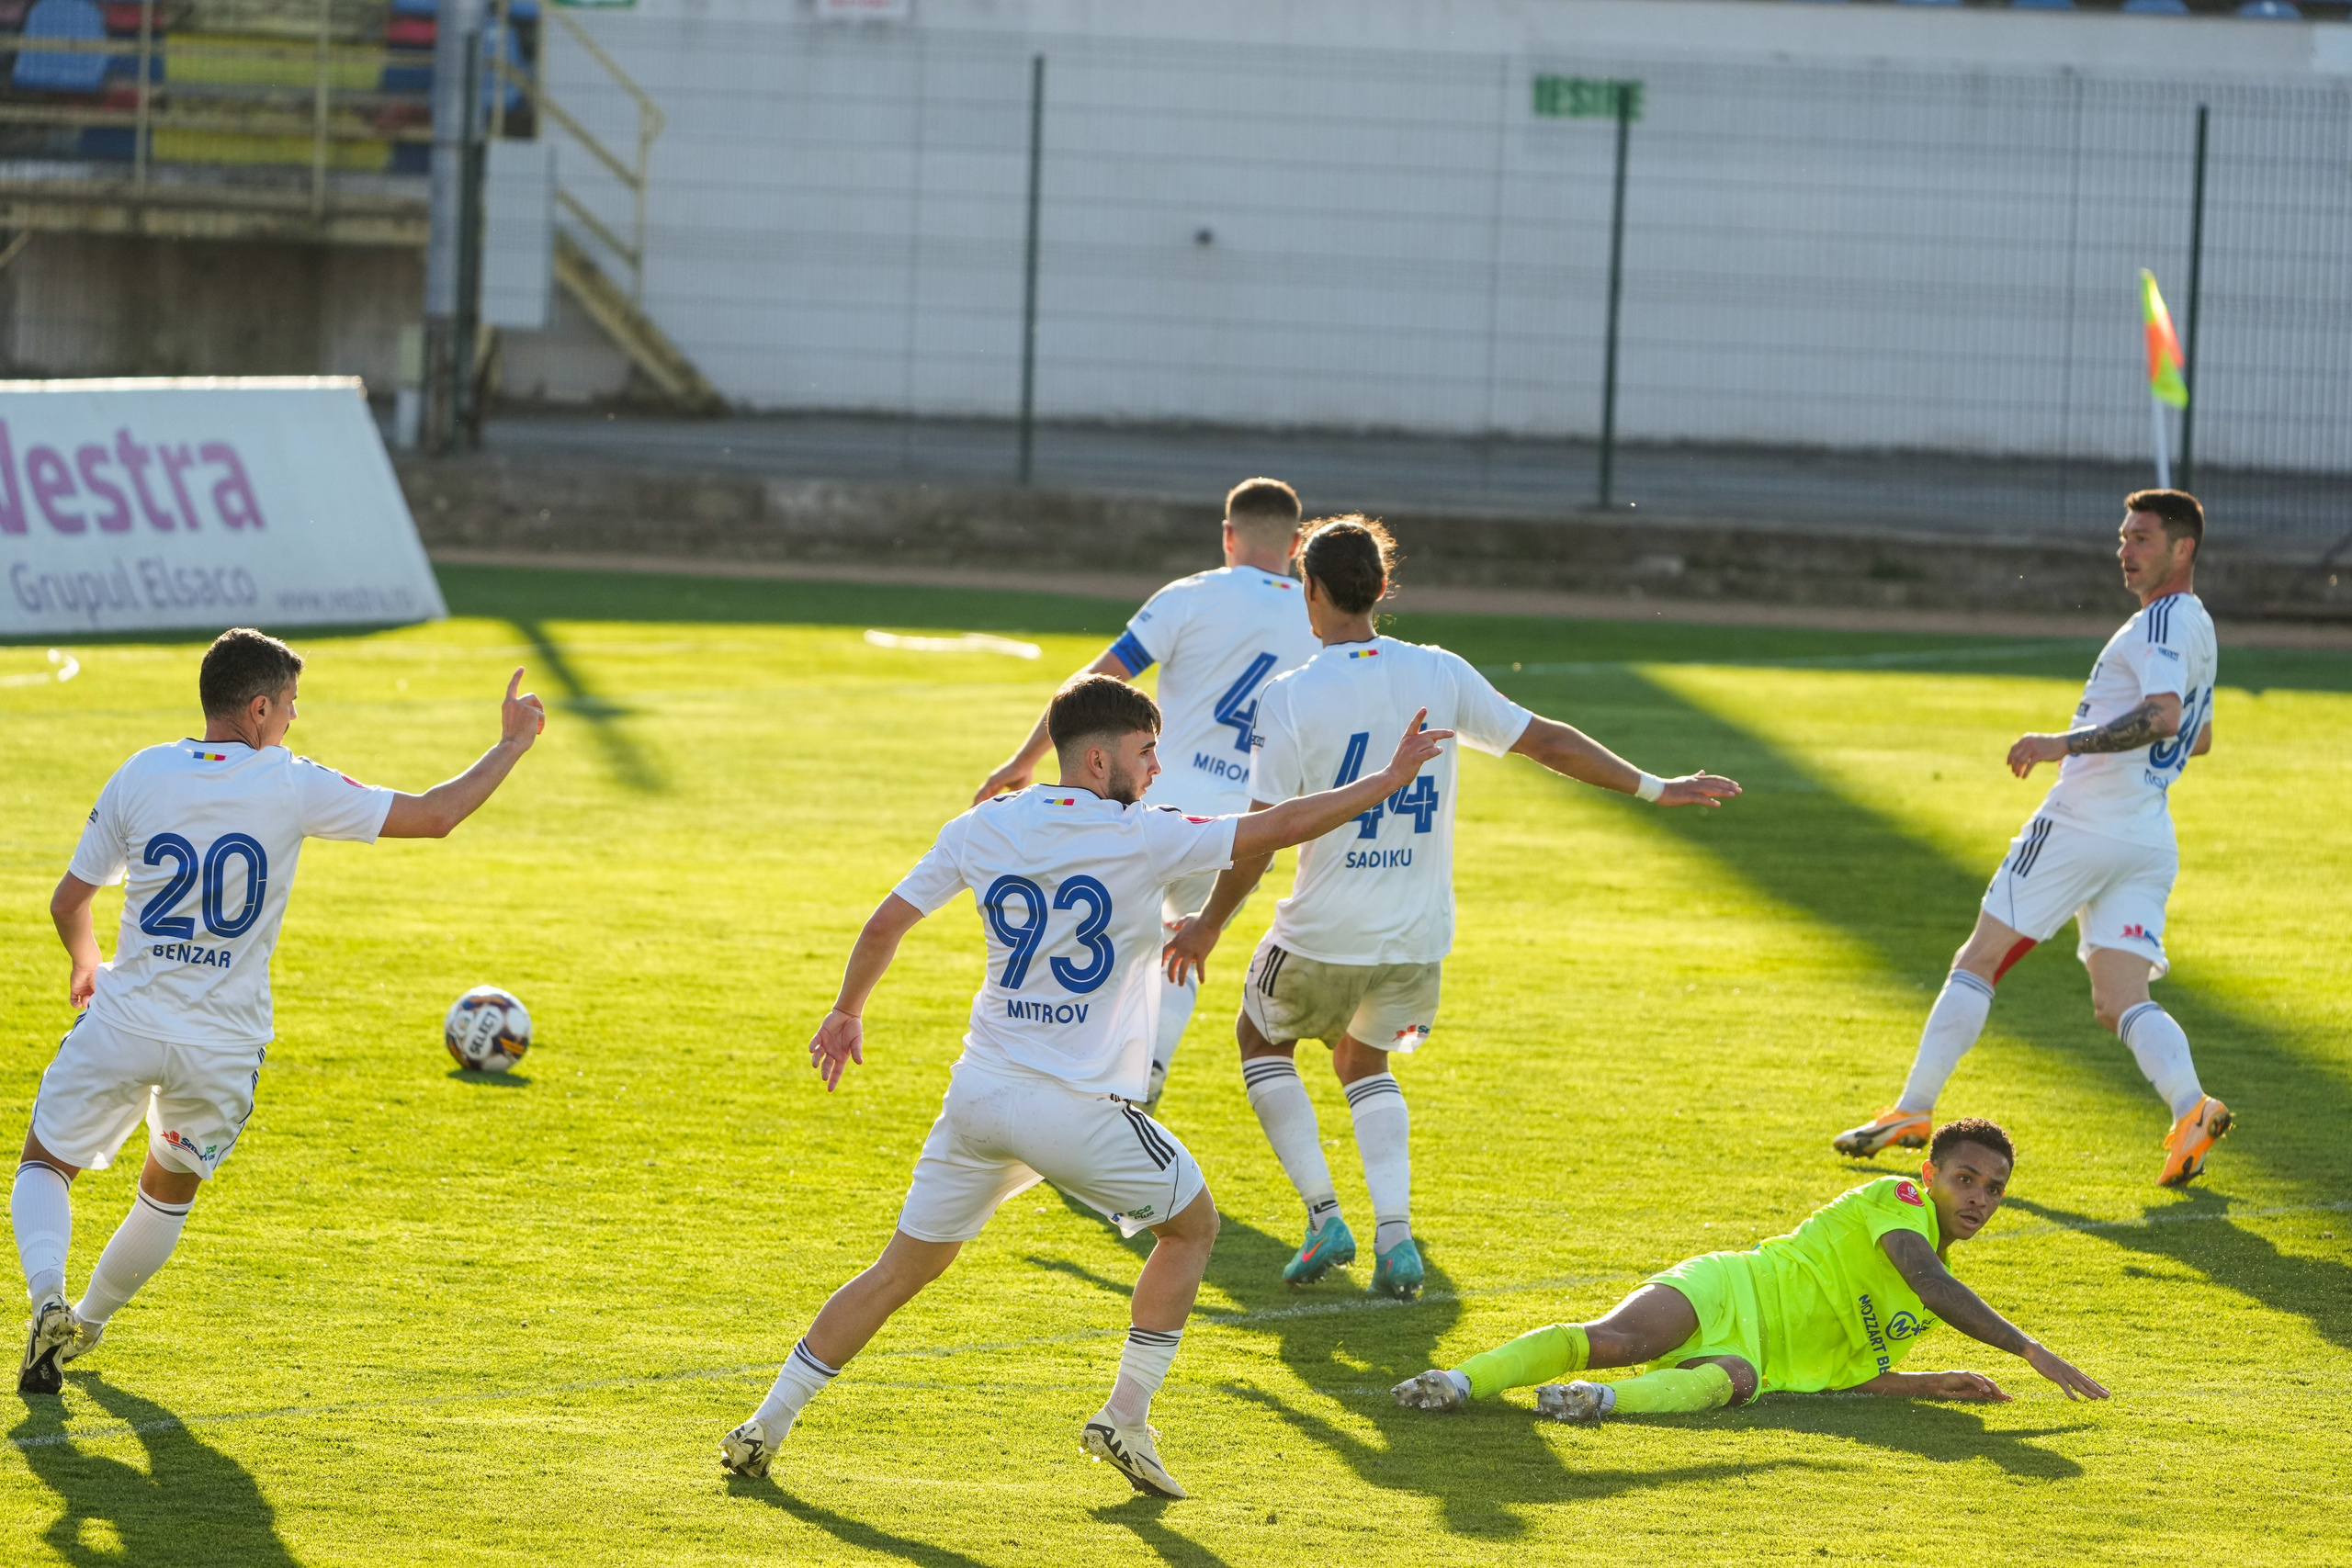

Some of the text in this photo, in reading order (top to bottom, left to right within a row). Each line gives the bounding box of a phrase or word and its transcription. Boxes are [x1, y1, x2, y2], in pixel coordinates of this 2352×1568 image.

[8, 554, 259, 623] Grupul Elsaco
[1214, 651, 1278, 754] 4
[1332, 722, 1440, 840] 44
[139, 831, 268, 941] 20
[1345, 848, 1413, 869] SADIKU
[152, 942, 232, 969] BENZAR
[983, 874, 1115, 995] 93
[469, 1011, 498, 1055] SELECT
[1007, 998, 1090, 1024] MITROV
[1859, 1293, 1887, 1352] MOZZART
